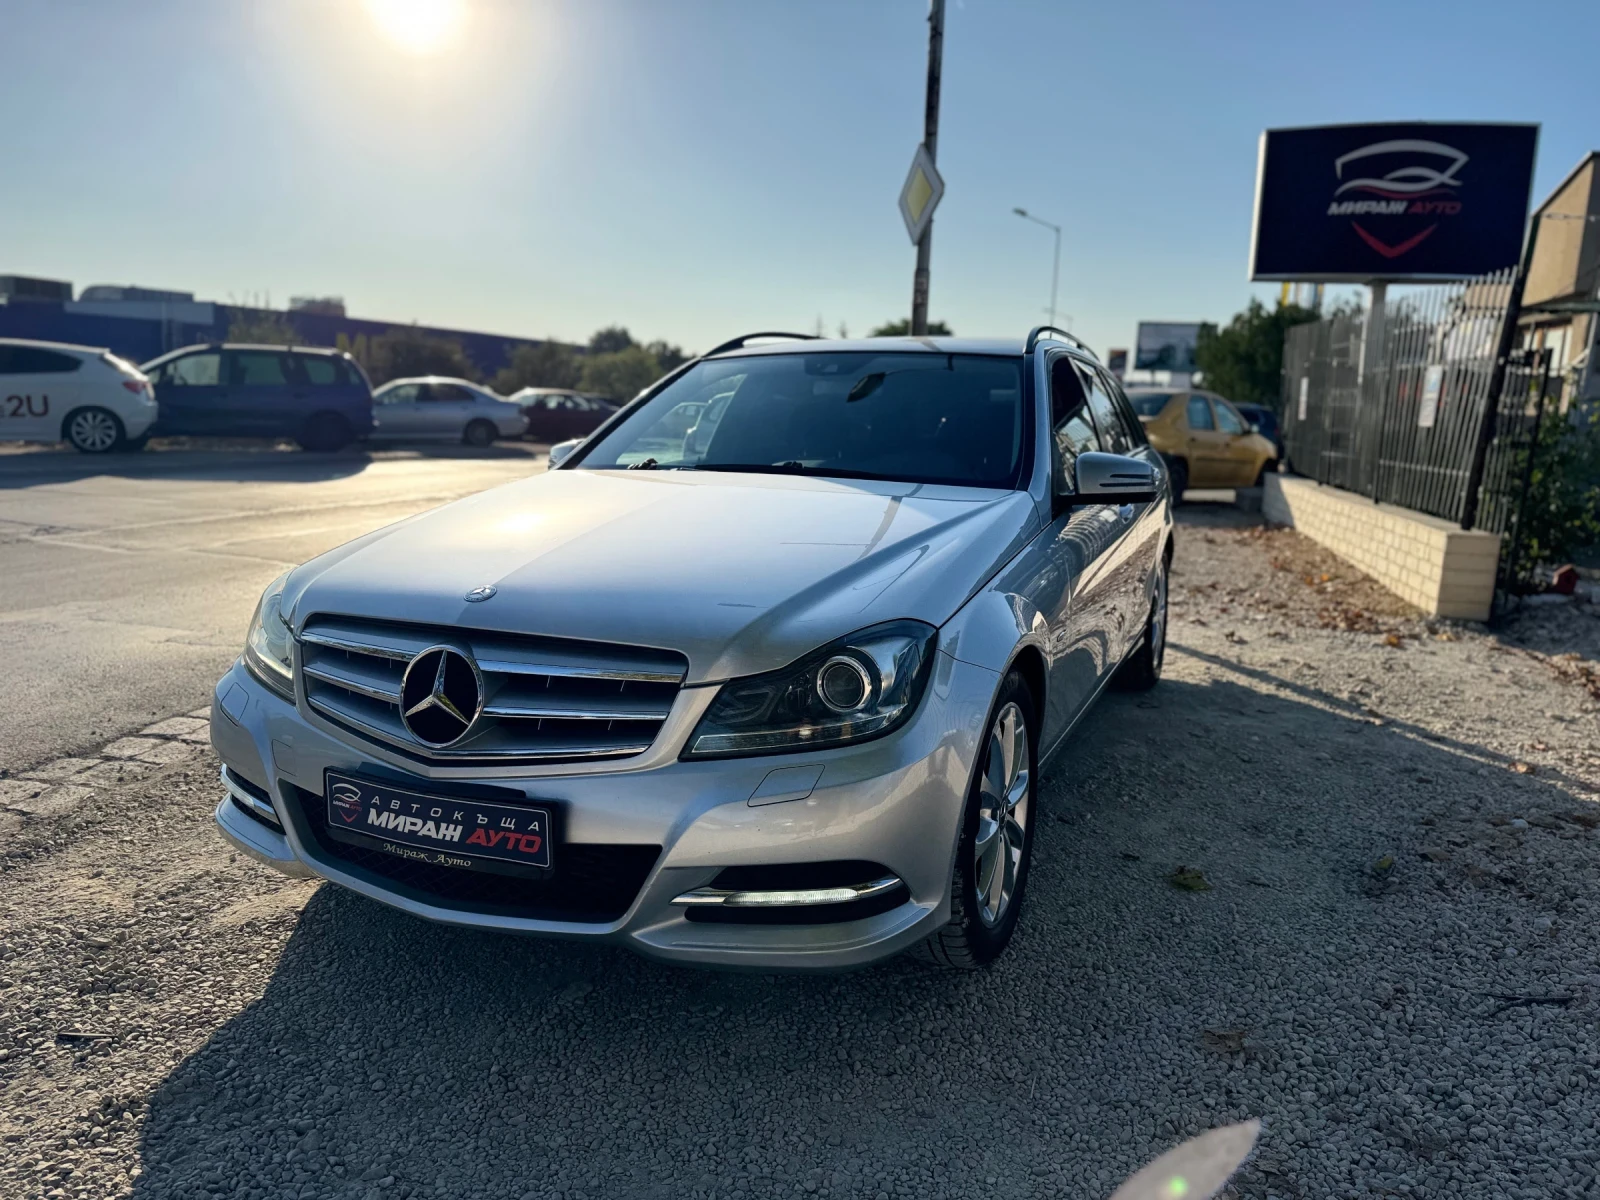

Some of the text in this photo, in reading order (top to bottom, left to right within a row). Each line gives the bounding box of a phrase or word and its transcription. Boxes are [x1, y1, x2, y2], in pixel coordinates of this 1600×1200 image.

[367, 807, 542, 853] МИРАЖ АУТО
[371, 795, 540, 832] АВТОКЪЩА
[383, 843, 471, 867] Мираж Ауто
